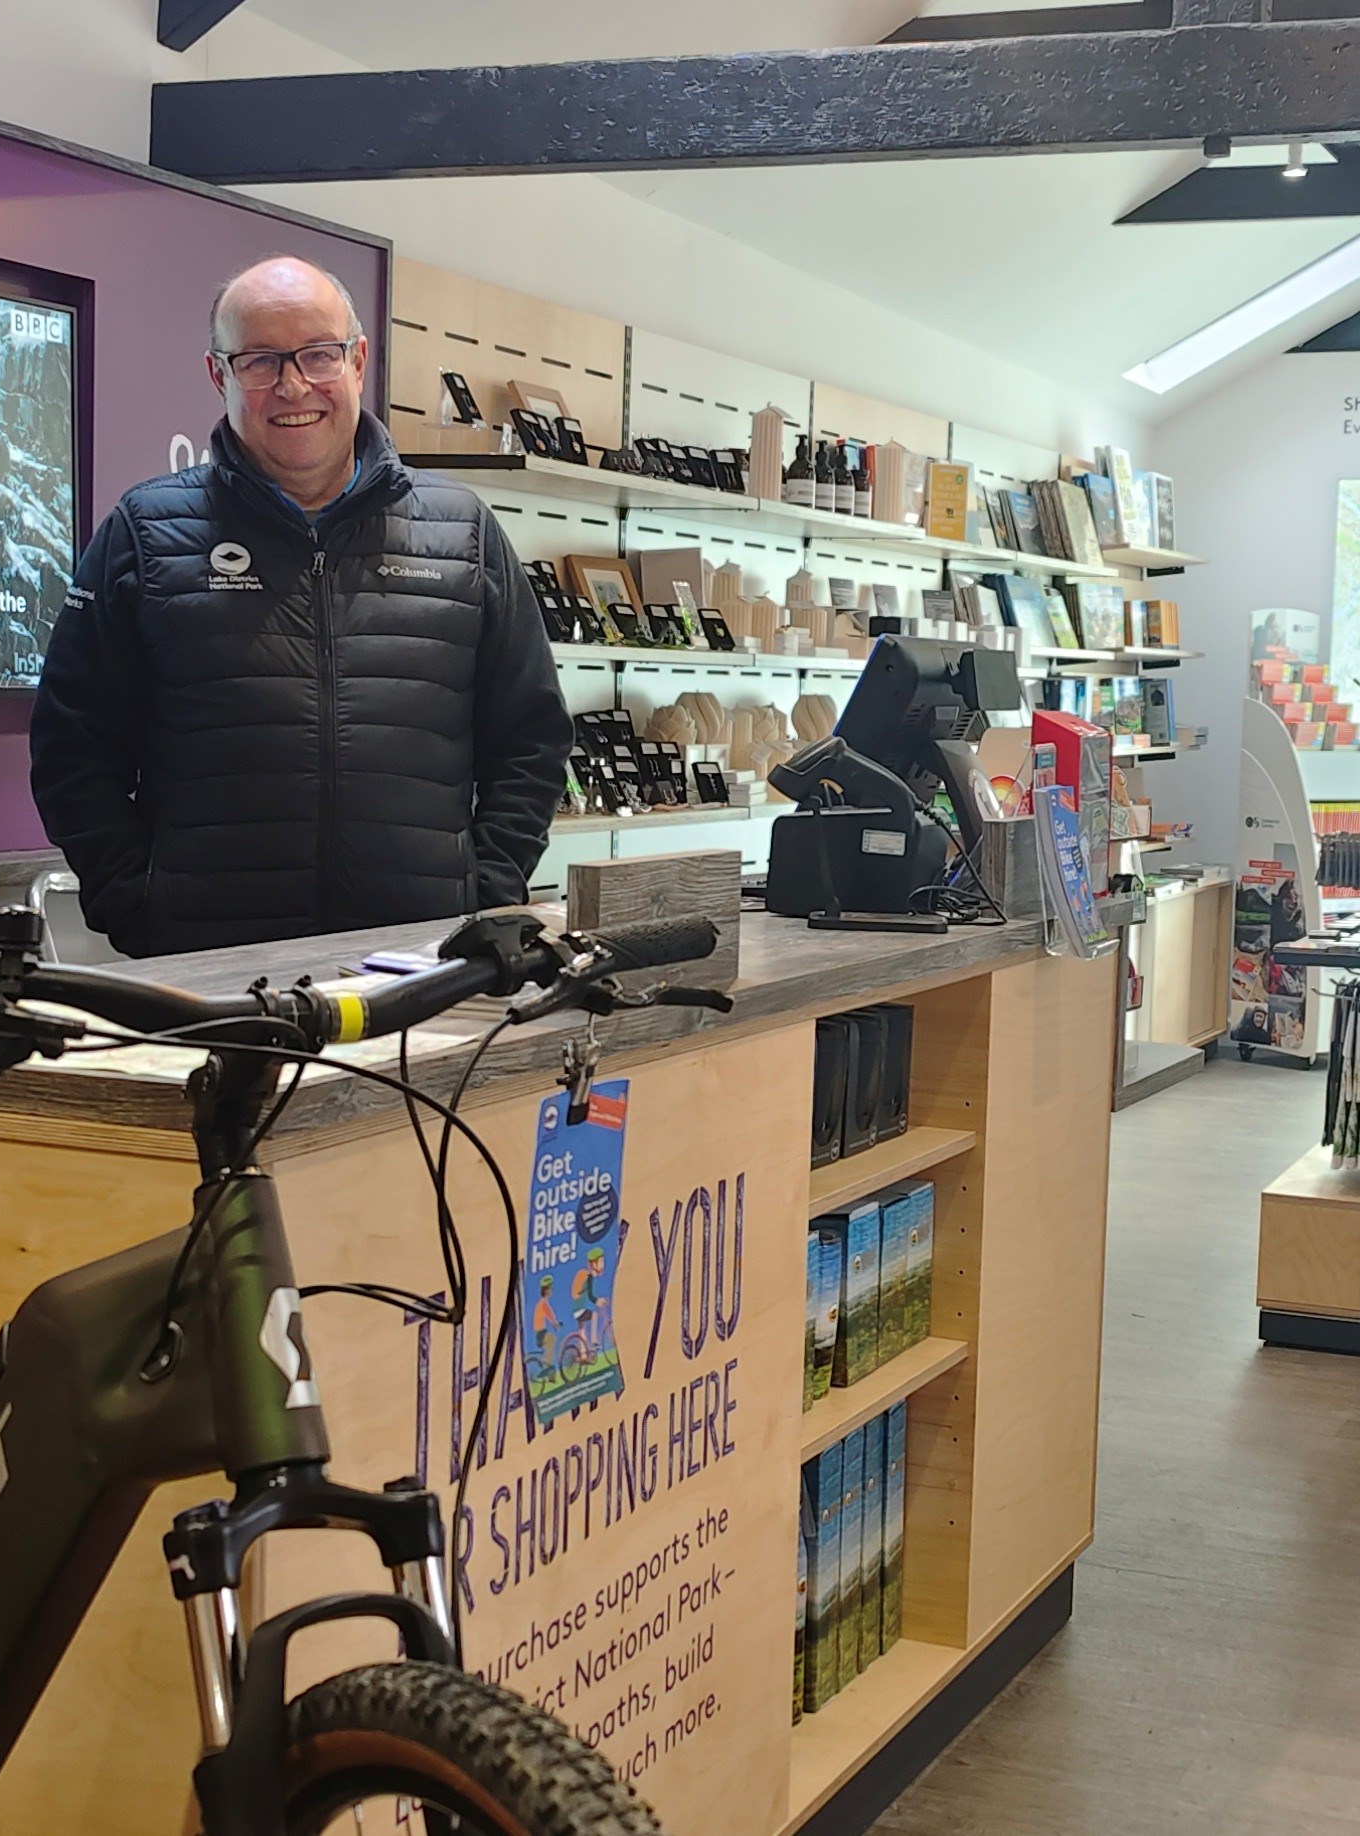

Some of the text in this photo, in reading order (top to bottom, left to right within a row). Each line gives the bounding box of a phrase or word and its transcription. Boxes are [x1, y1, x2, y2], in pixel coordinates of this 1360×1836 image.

[13, 311, 61, 341] BBC
[389, 564, 442, 580] Columbia
[534, 1166, 613, 1211] outside
[536, 1150, 574, 1183] Get
[530, 1231, 578, 1274] hire!
[532, 1207, 577, 1243] Bike
[403, 1172, 746, 1490] THA YOU
[489, 1403, 659, 1597] SHOPPING
[666, 1357, 738, 1490] HERE
[594, 1530, 691, 1615] supports
[695, 1505, 730, 1548] the
[572, 1593, 672, 1699] National
[662, 1622, 716, 1694] build
[617, 1692, 722, 1785] uch more.
